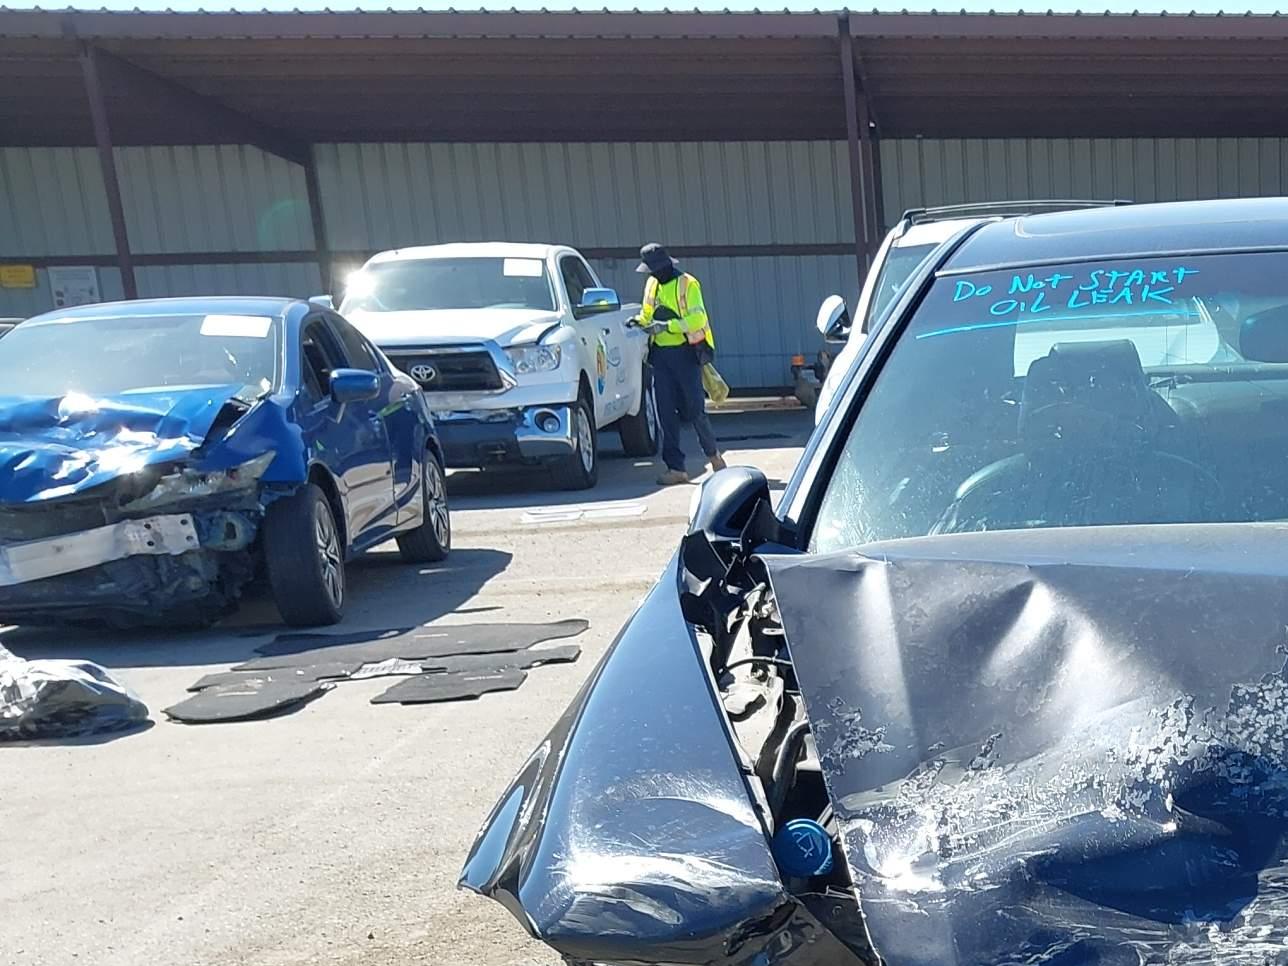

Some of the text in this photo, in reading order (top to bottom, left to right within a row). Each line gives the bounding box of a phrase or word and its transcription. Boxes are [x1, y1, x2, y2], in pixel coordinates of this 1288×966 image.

[953, 281, 992, 301] Do
[1079, 266, 1200, 291] START
[990, 284, 1175, 316] OIL LEAK
